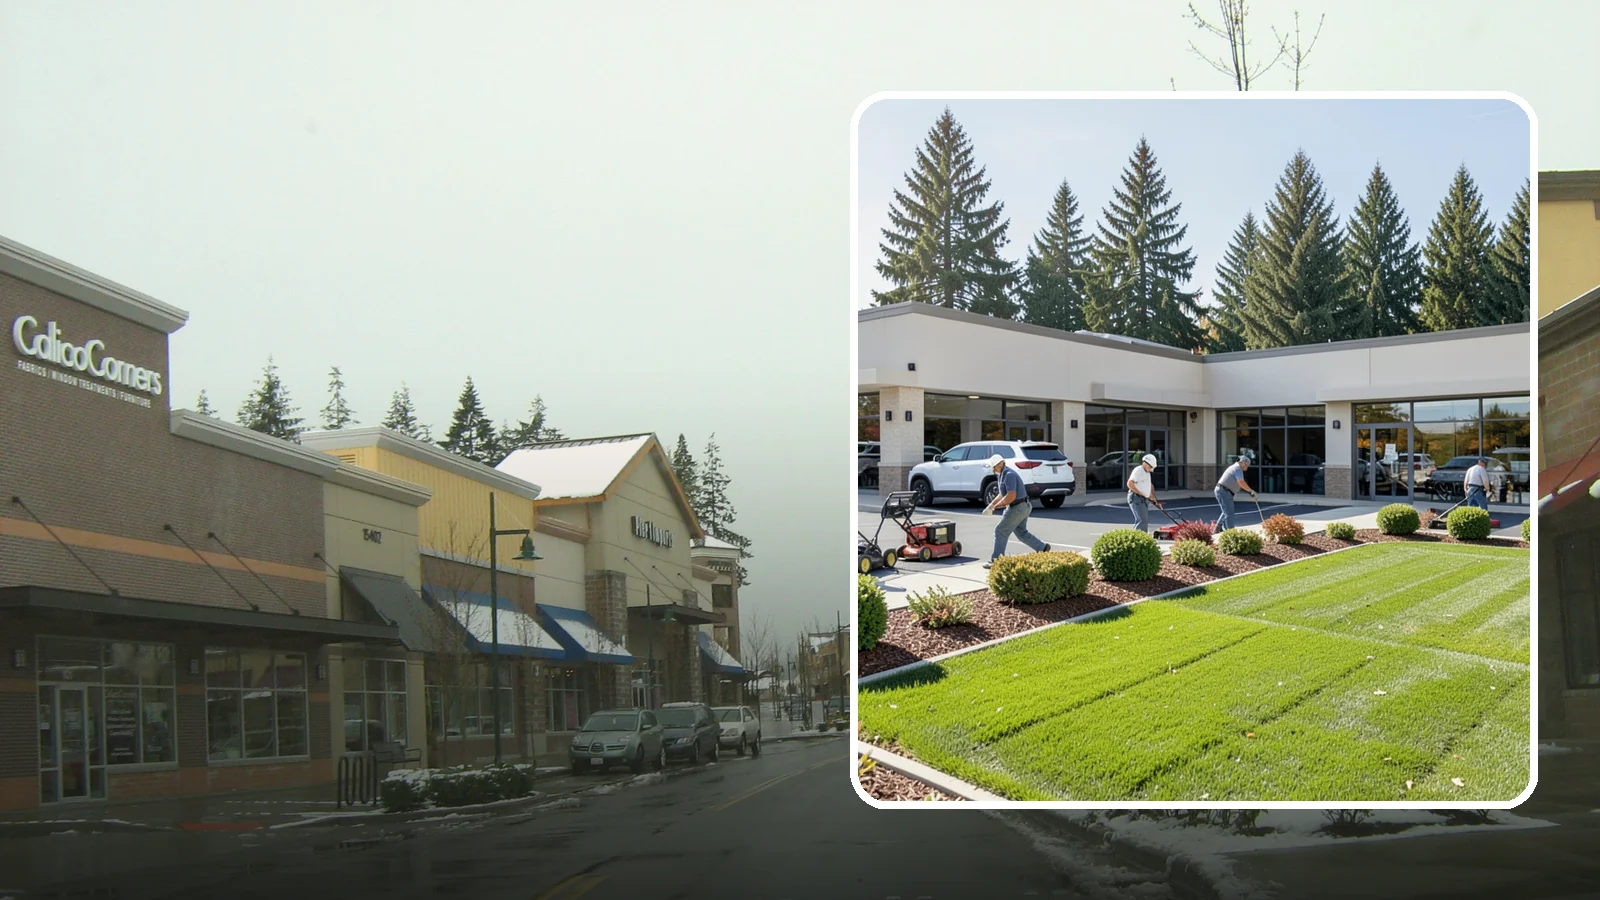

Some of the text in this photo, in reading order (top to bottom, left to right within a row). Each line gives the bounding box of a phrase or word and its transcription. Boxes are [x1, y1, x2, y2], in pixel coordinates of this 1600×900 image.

[17, 360, 47, 378] FABRICS
[51, 370, 78, 386] WINDOW
[79, 378, 117, 399] TREATMENTS
